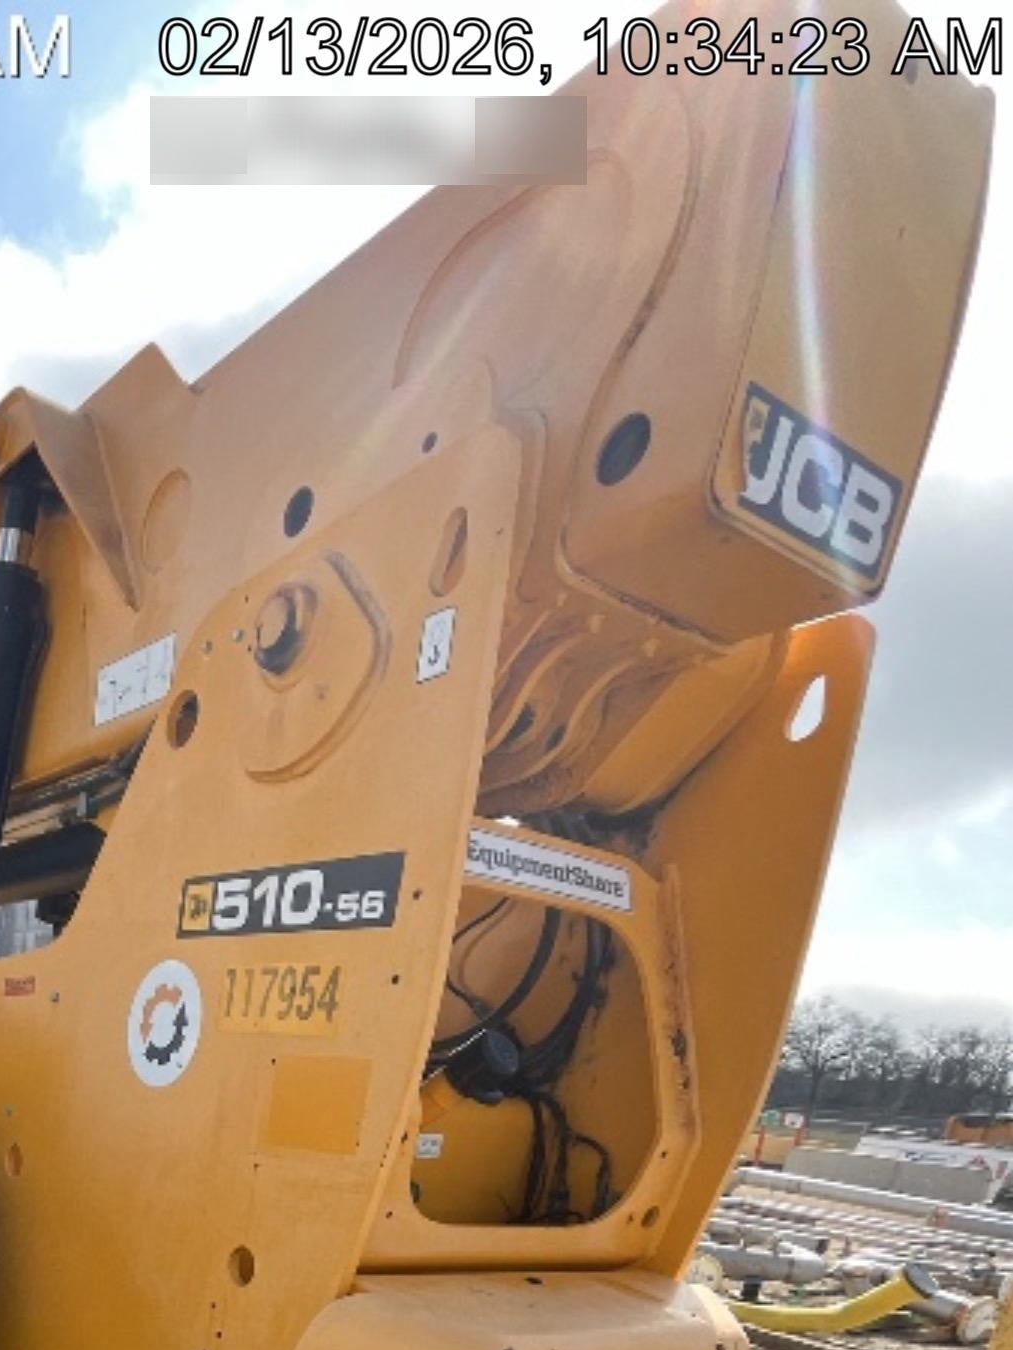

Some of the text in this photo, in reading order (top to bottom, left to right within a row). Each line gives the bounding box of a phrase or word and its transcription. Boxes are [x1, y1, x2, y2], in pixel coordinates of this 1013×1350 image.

[740, 415, 893, 566] JCB
[467, 838, 625, 898] EquipmentShare
[222, 964, 342, 1023] 117954
